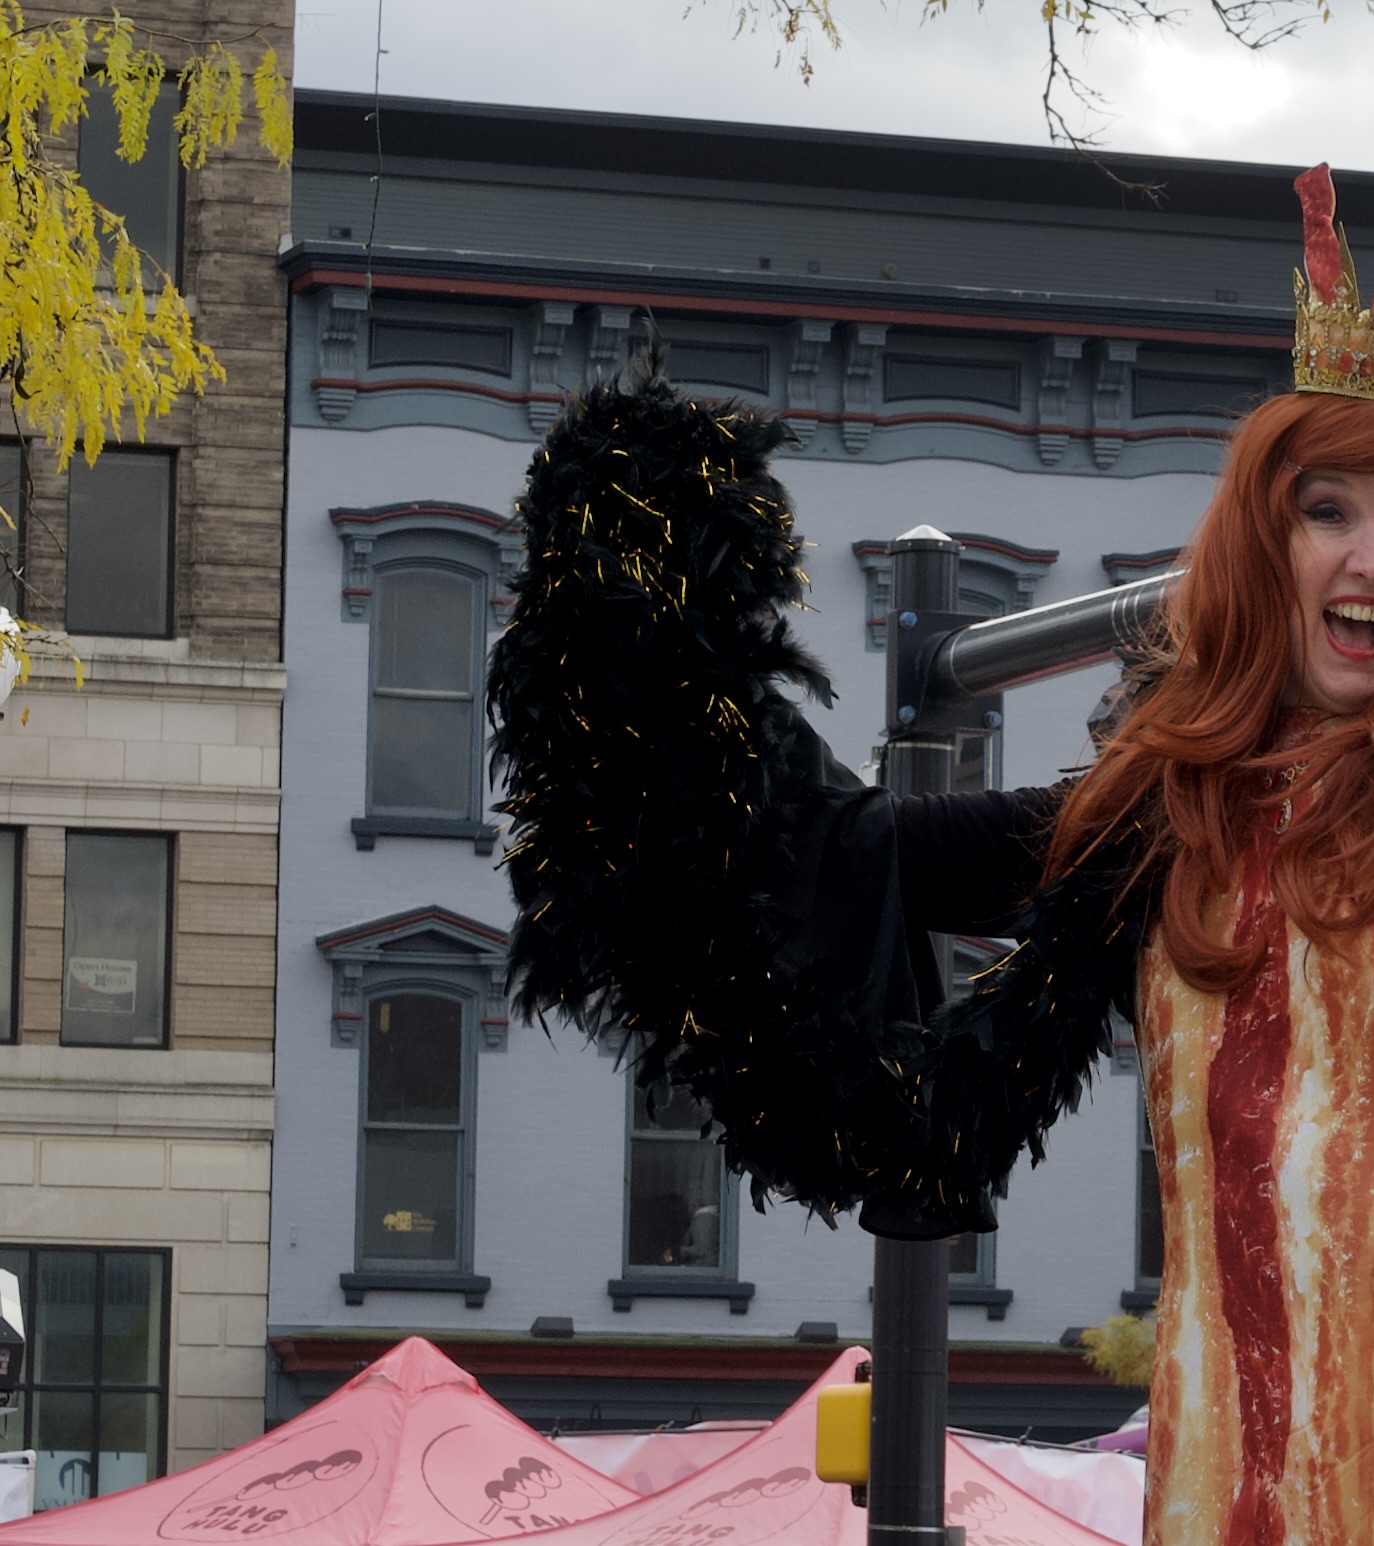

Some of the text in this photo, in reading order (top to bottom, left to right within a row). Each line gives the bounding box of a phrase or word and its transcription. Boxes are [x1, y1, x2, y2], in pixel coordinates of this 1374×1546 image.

[206, 1505, 288, 1522] TANG
[181, 1519, 268, 1534] HULU
[503, 1514, 571, 1530] TAN
[647, 1523, 735, 1539] TANG
